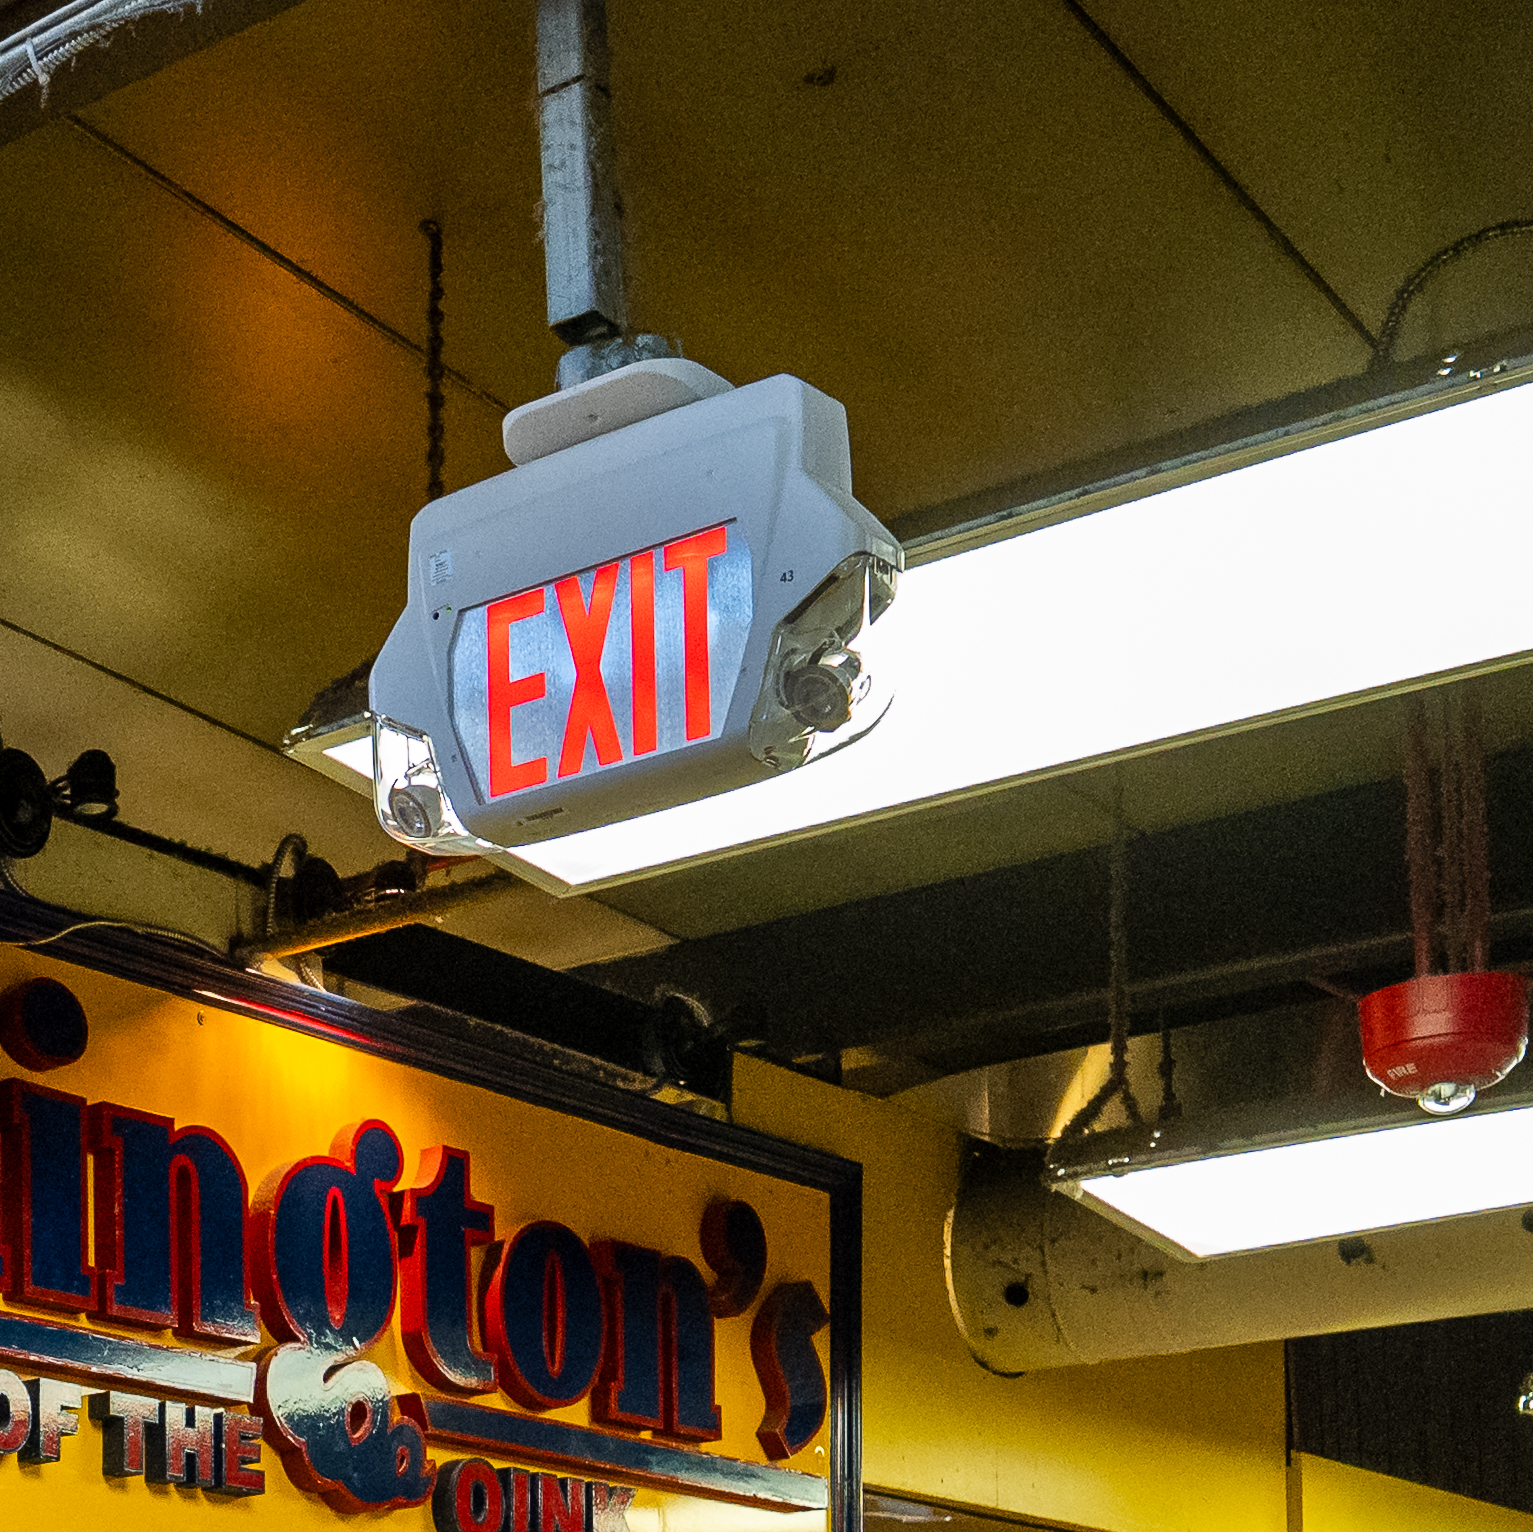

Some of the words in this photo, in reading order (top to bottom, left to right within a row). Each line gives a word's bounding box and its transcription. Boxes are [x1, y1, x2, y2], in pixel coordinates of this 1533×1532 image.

[780, 569, 795, 584] 43
[486, 526, 727, 799] EXIT
[89, 1389, 266, 1497] THE
